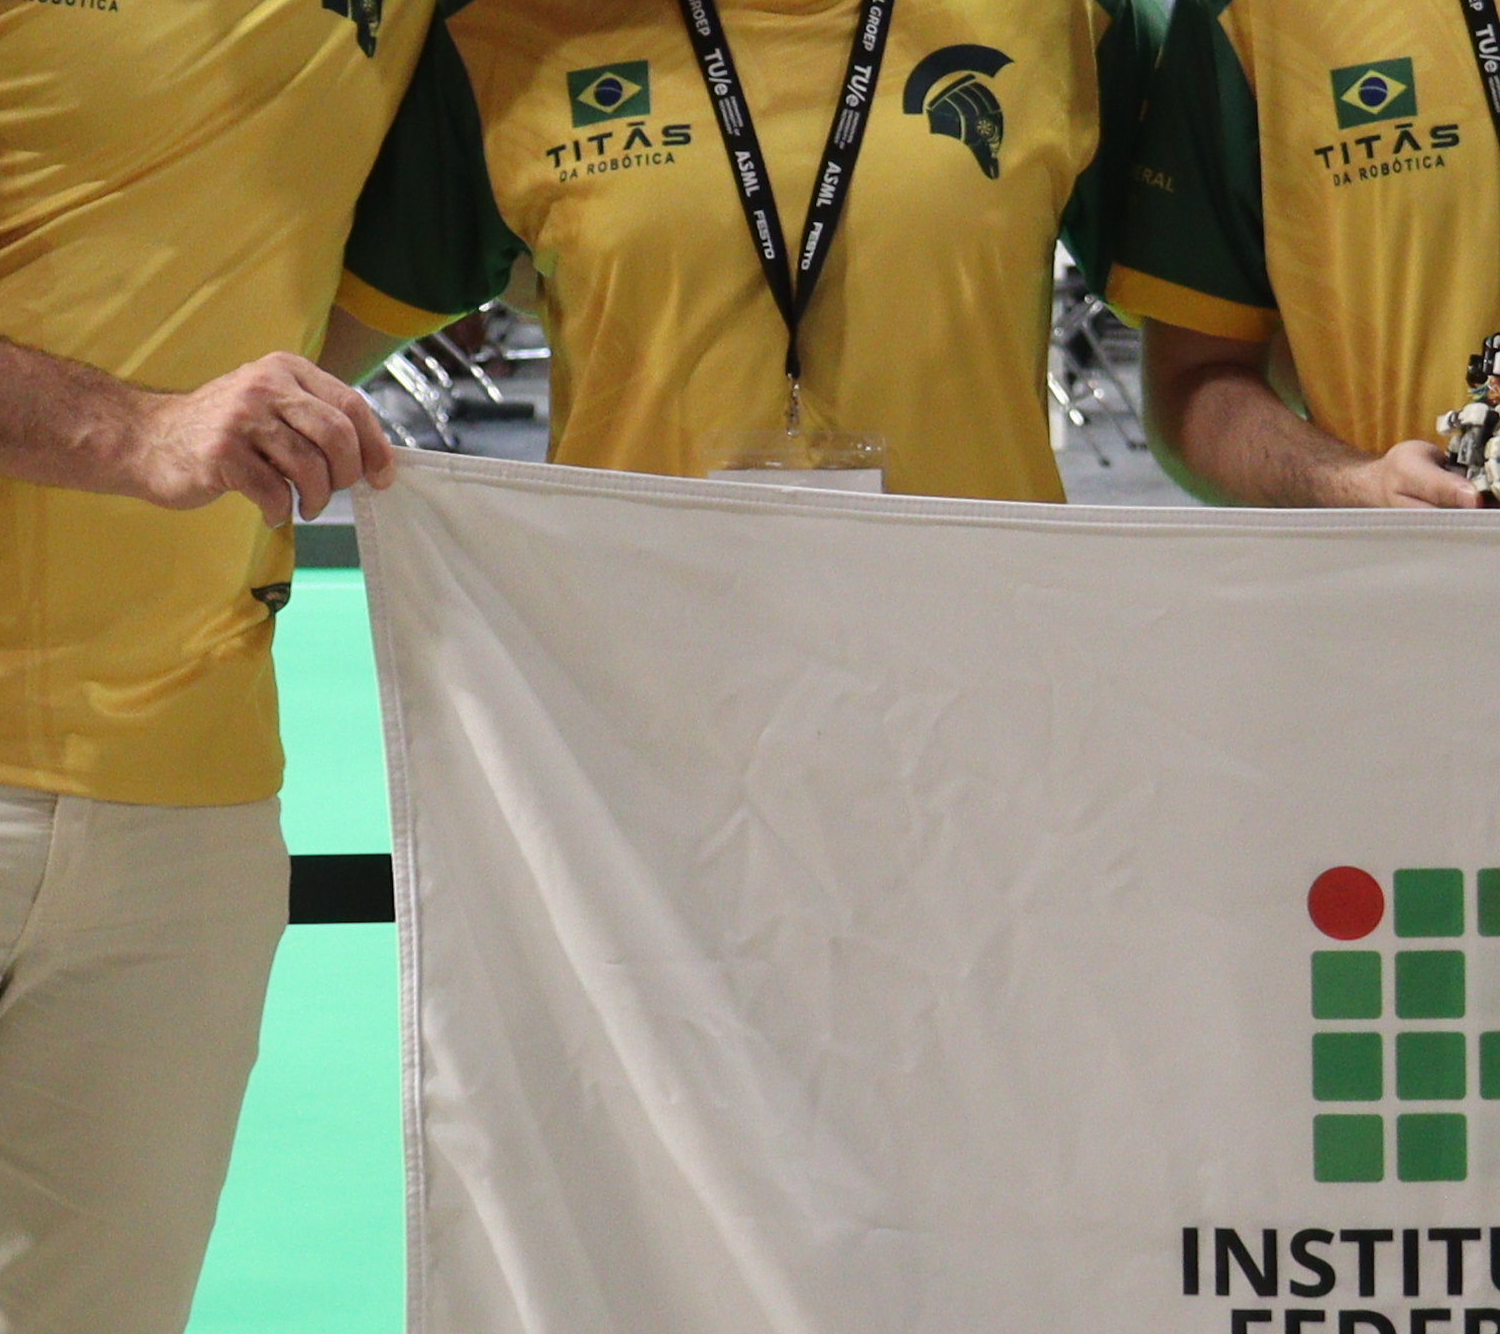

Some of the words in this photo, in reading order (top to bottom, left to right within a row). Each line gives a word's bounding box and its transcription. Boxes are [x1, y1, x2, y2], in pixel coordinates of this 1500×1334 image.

[862, 5, 882, 52] GROEP
[704, 47, 732, 97] TU/e
[845, 64, 873, 107] TU/e
[546, 121, 692, 169] TITÃS
[559, 166, 579, 183] DA
[587, 151, 675, 175] ROBÓTICA
[1315, 123, 1461, 169] TITÃS
[735, 150, 760, 197] ASML
[816, 161, 842, 208] ASML
[1333, 172, 1352, 187] DA
[1359, 154, 1445, 179] ROBÓTICA
[753, 209, 775, 260] FESTO
[801, 222, 823, 271] FESTO
